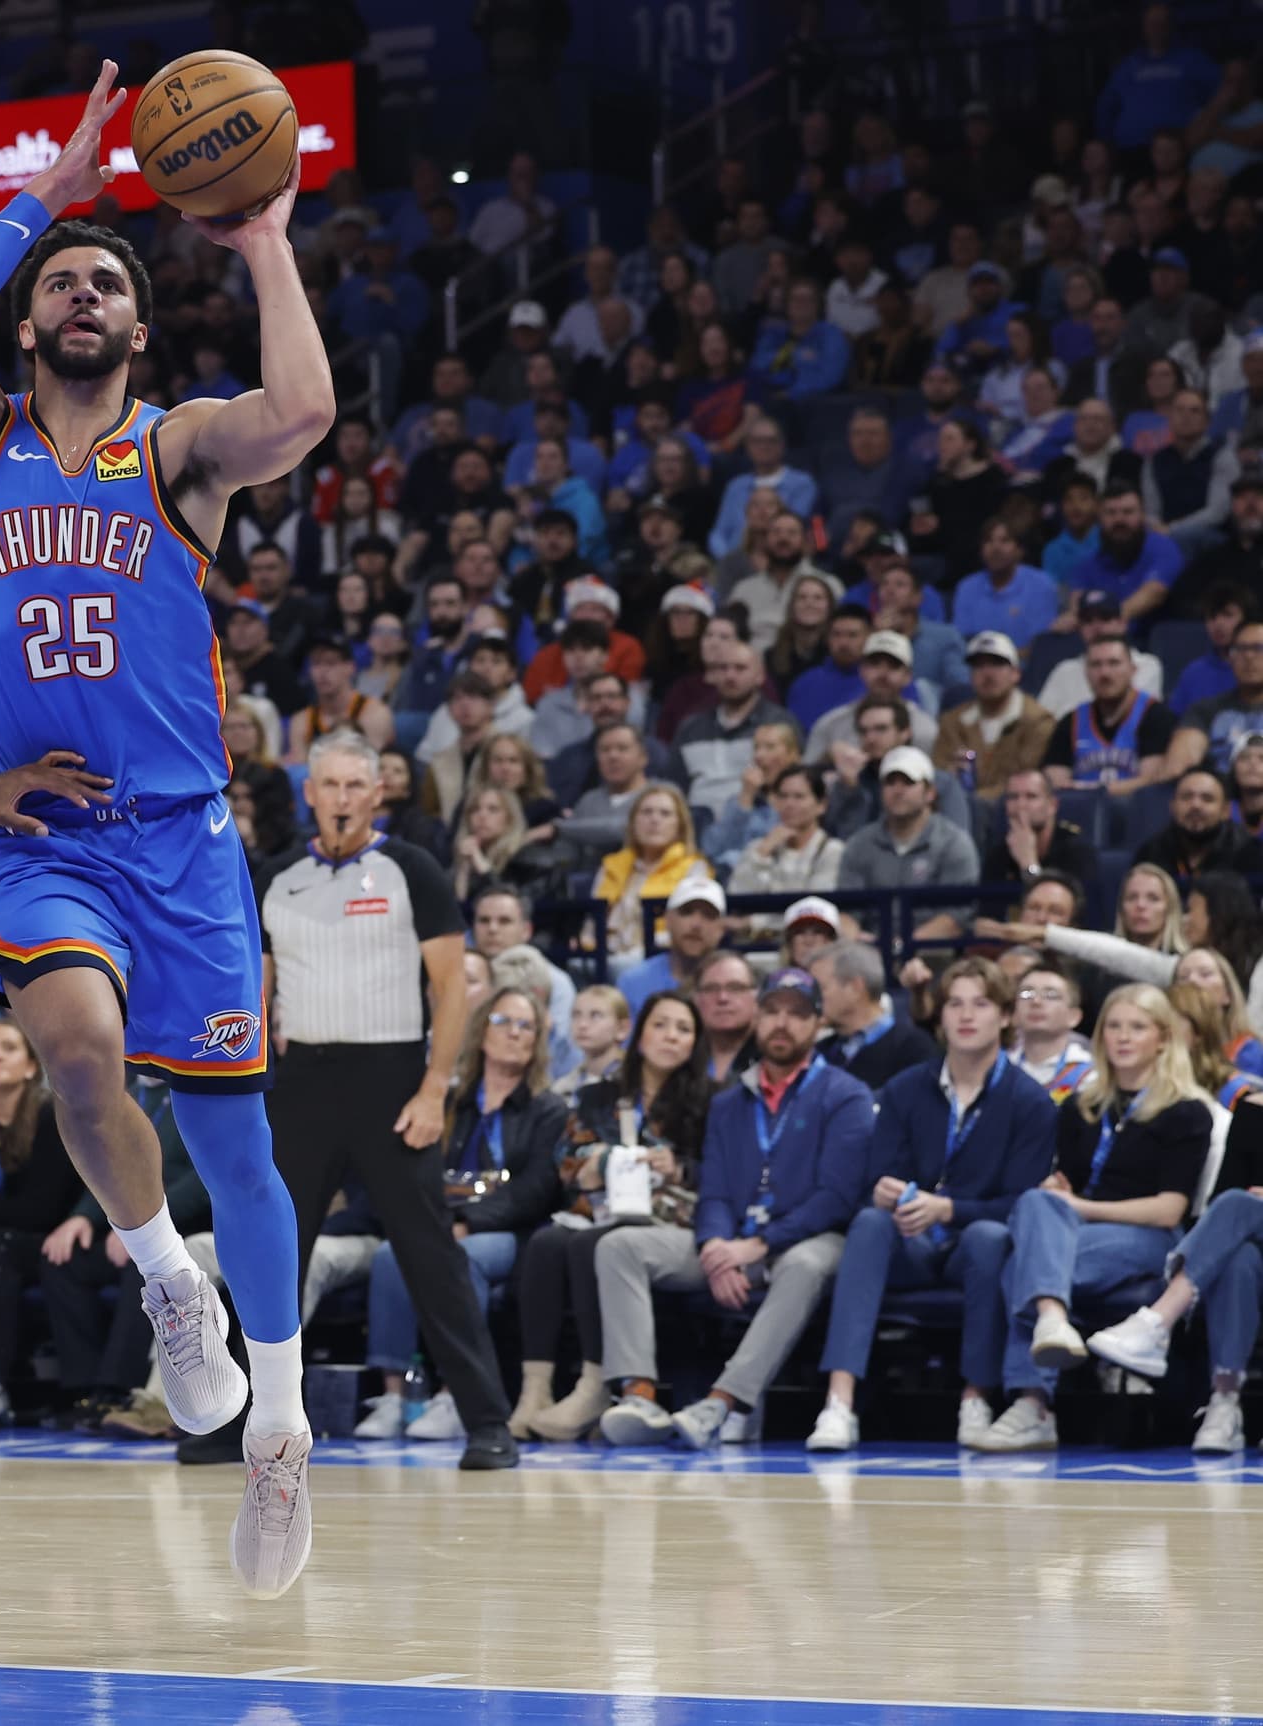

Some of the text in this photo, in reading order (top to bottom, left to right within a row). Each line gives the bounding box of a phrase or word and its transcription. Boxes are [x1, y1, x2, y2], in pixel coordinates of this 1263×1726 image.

[156, 109, 263, 176] Wilson
[18, 593, 117, 682] 25
[206, 1019, 248, 1048] OKC
